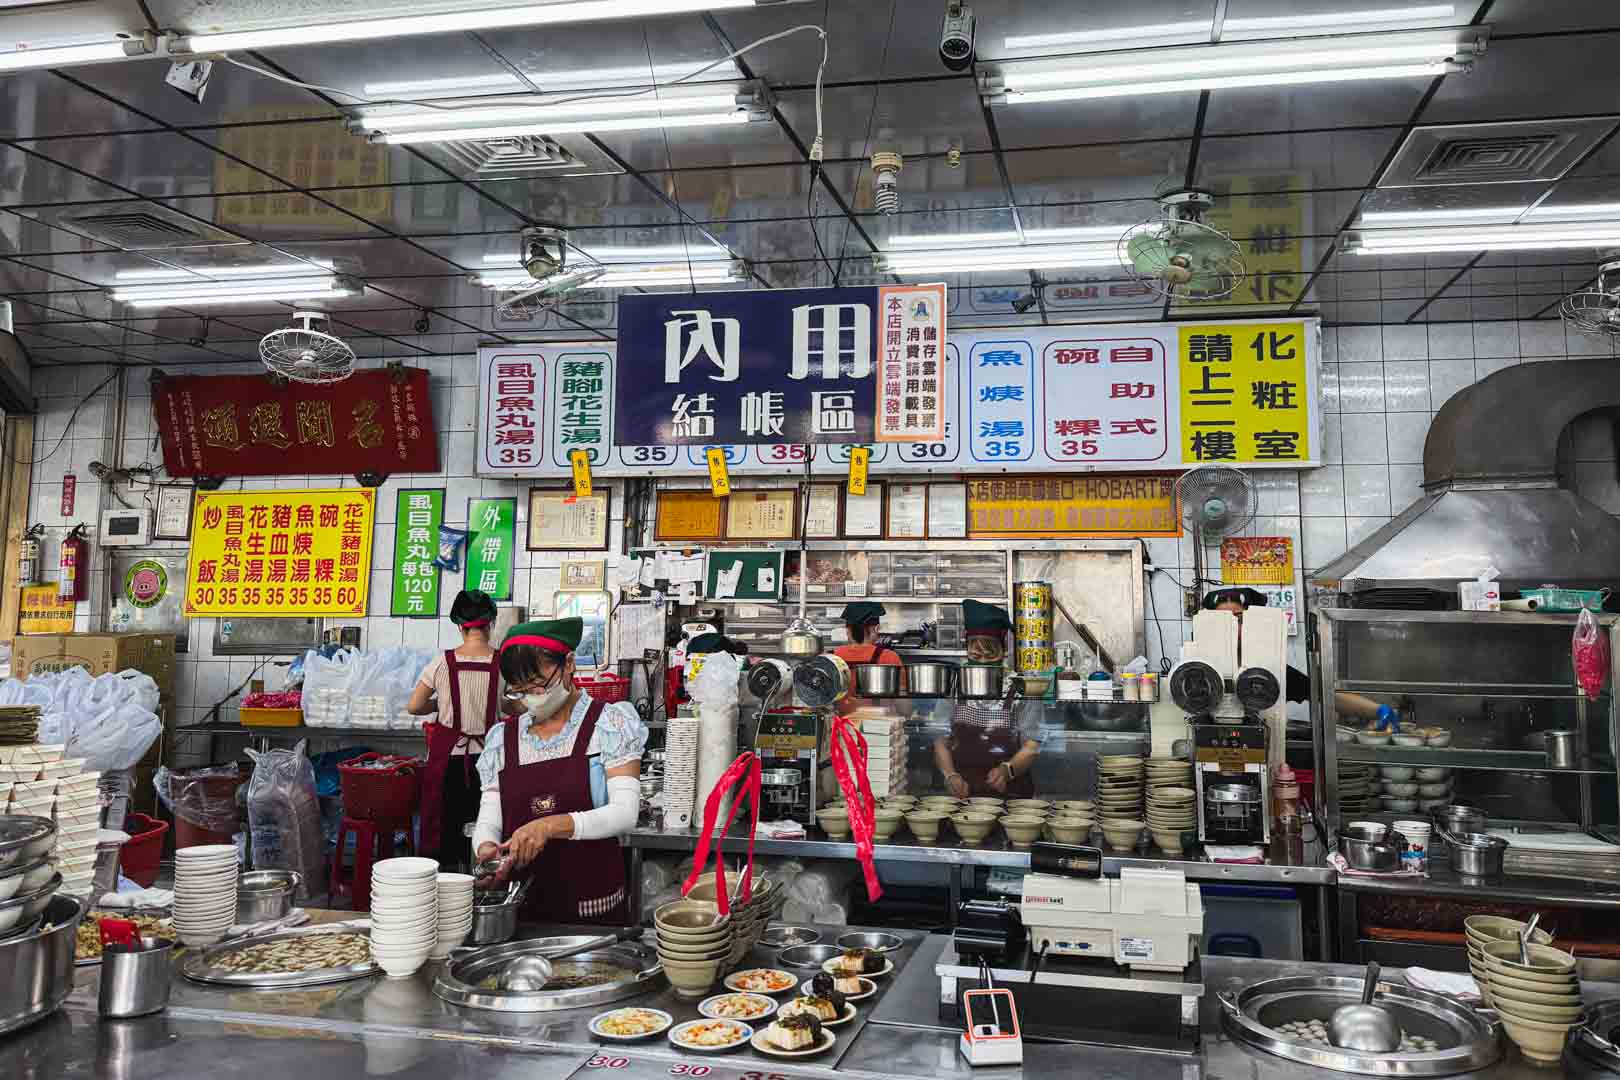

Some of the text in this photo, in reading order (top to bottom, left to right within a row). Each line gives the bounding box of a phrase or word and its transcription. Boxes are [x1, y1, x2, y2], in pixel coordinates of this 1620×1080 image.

[664, 303, 871, 384] 內用
[885, 297, 903, 431] 本店開立雲端發票
[905, 327, 920, 428] 消費請用載具
[921, 326, 937, 428] 儲存雲端發票
[495, 362, 537, 445] 虱目魚丸湯
[561, 361, 604, 445] 豬腳花生湯
[672, 390, 857, 438] 結帳區
[1054, 348, 1103, 437] 碗粿
[1109, 346, 1157, 435] 自助式
[1188, 333, 1237, 460] 請上二樓
[1250, 331, 1301, 459] 化粧室
[500, 448, 532, 464] 35
[634, 447, 667, 461] 35
[771, 445, 806, 460] 35
[911, 443, 947, 458] 30
[985, 441, 1021, 456] 35
[1061, 440, 1098, 456] 35
[196, 505, 222, 583] 炒飯
[220, 505, 245, 583] 虱目魚丸湯
[243, 506, 268, 583] 花生湯
[267, 505, 292, 583] 豬血湯
[314, 505, 340, 583] 碗粿
[338, 503, 364, 583] 花生豬腳湯
[405, 495, 432, 559] 虱目魚丸
[479, 505, 502, 593] 外帶區
[195, 587, 357, 605] 30 35 35 35 35 35 60
[401, 561, 434, 576] 每包
[403, 579, 432, 593] 120
[407, 596, 424, 612] 元
[1276, 591, 1293, 601] 16
[588, 1055, 629, 1068] 30
[670, 1064, 711, 1076] 30
